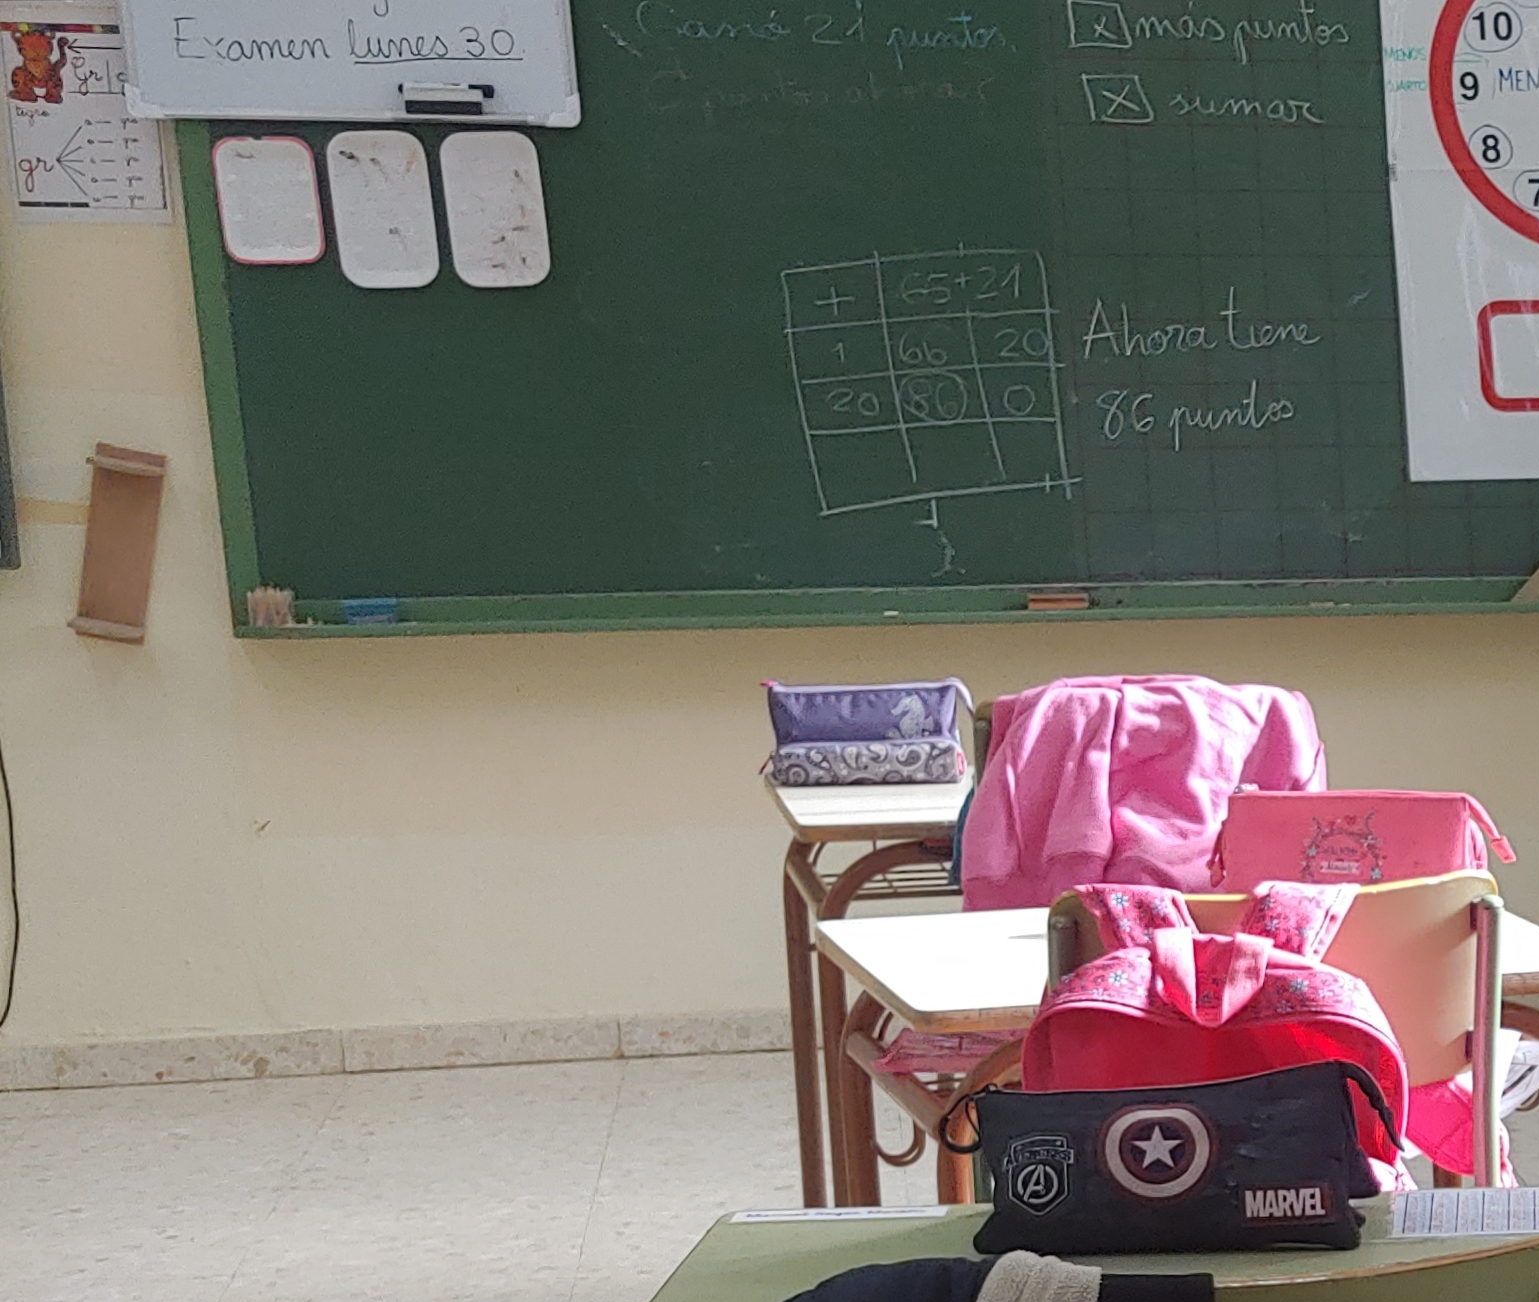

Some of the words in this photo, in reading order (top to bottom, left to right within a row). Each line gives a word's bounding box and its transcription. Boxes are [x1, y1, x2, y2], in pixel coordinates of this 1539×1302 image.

[174, 17, 331, 62] Examen
[348, 18, 449, 60] lunes
[1234, 4, 1349, 65] puntos
[1472, 11, 1513, 41] 10
[1459, 71, 1479, 101] 9
[1170, 93, 1325, 124] sumar
[1481, 134, 1501, 163] 8
[19, 157, 54, 193] gr
[1083, 298, 1217, 359] Ahora
[1219, 286, 1321, 349] tiene
[995, 328, 1048, 358] 20
[827, 388, 879, 417] 20
[1096, 388, 1155, 440] 86
[1169, 379, 1294, 451] puntos
[1245, 1187, 1325, 1218] MARVEL
